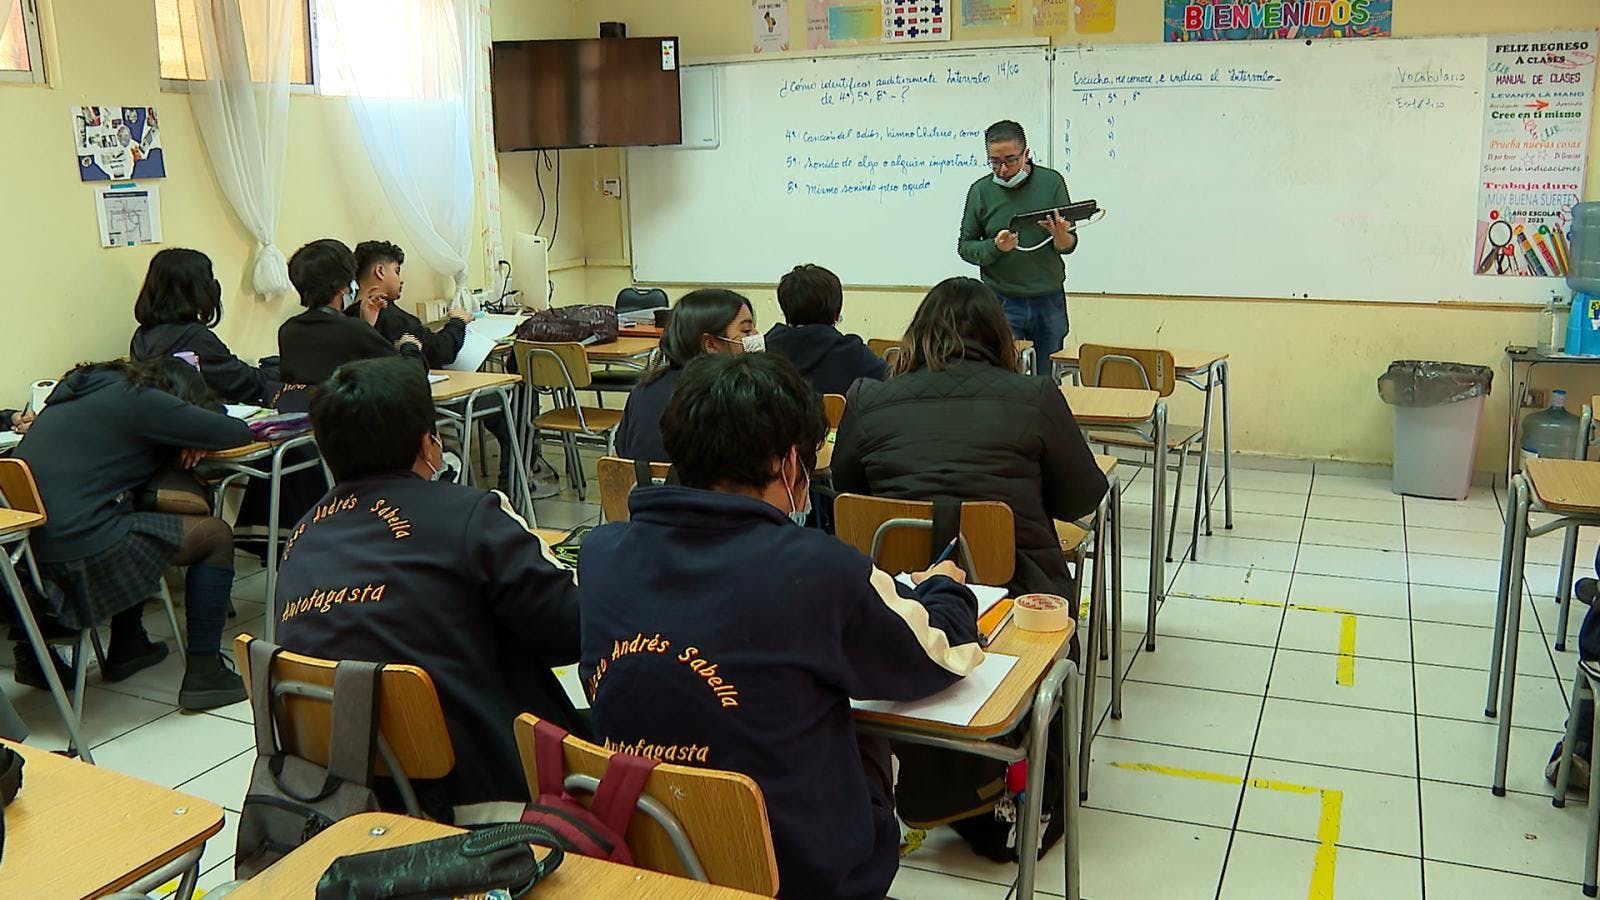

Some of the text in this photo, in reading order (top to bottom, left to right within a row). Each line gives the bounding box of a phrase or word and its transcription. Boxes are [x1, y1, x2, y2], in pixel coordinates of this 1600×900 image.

[1184, 0, 1370, 30] BIENVENIDOS
[1495, 41, 1589, 53] FELIZ REGRESO
[1515, 55, 1566, 64] A CLASES
[1495, 73, 1581, 85] MANUAL DE CLASES
[1491, 111, 1516, 119] Cree
[1533, 110, 1542, 119] ti
[1525, 163, 1581, 172] indicaciones
[1483, 182, 1578, 191] Trabaja duro
[1509, 194, 1538, 206] BUENA
[312, 493, 358, 524] Andrés
[370, 498, 413, 540] Sabella
[281, 583, 388, 622] Antofagasta
[611, 632, 671, 662] Andrés
[677, 646, 739, 708] Sabella
